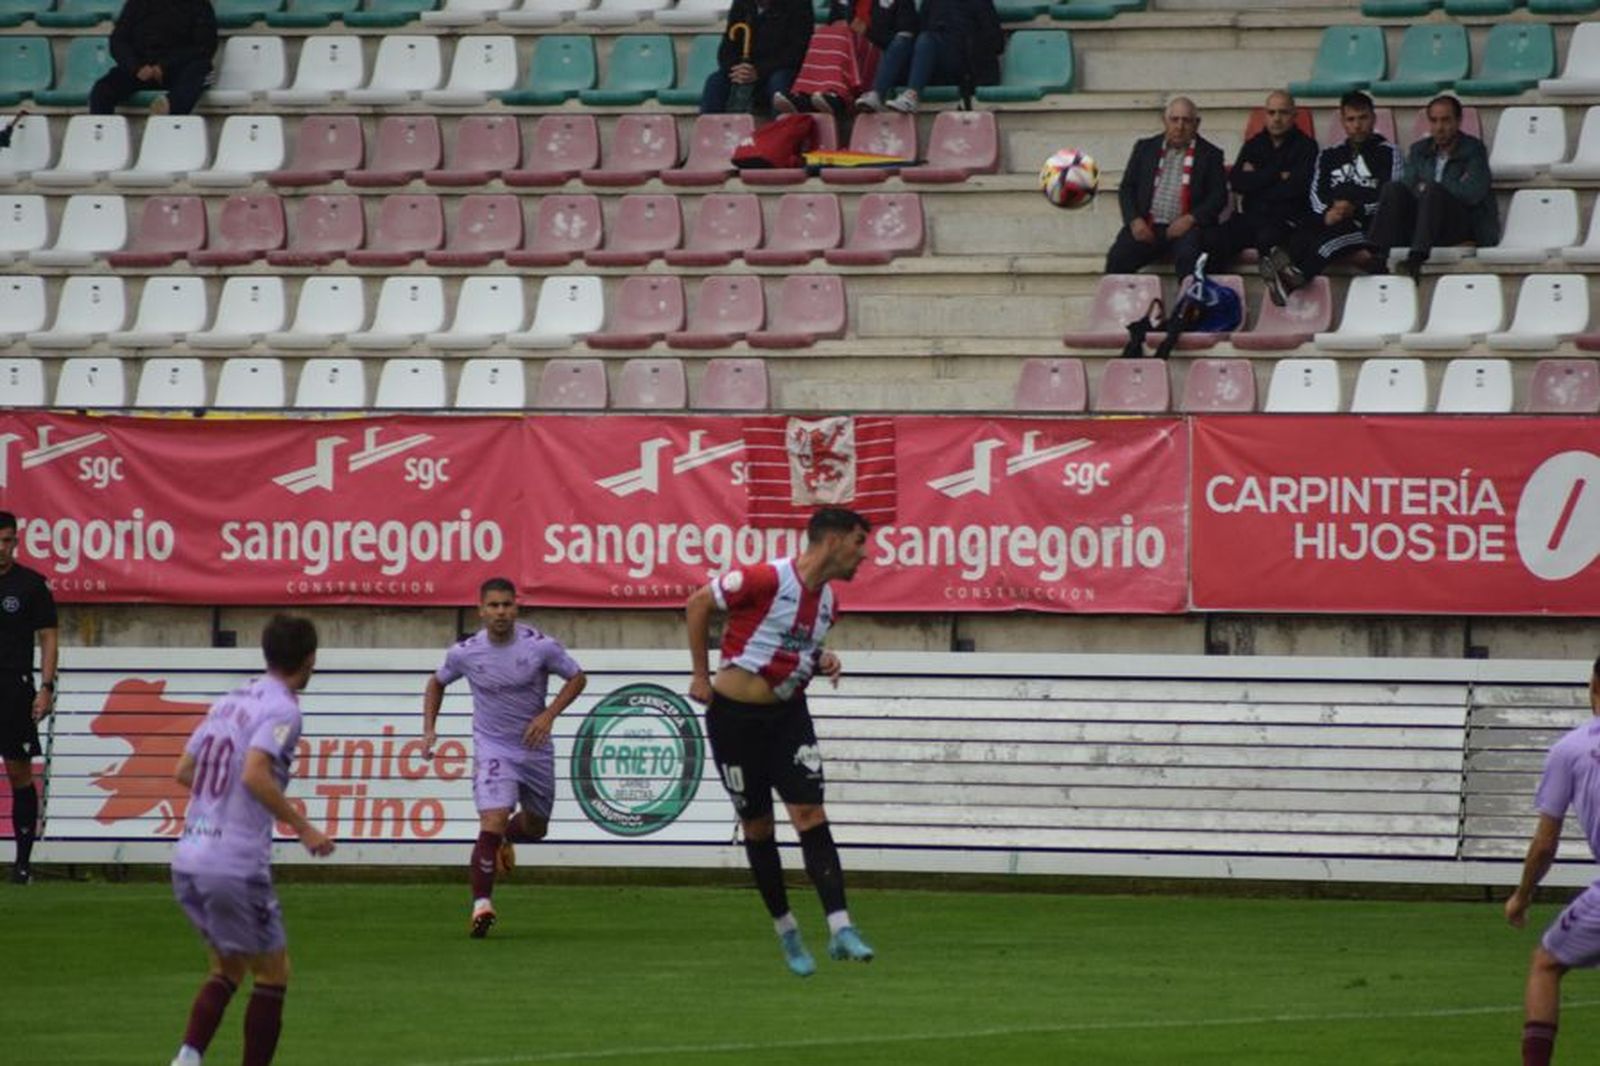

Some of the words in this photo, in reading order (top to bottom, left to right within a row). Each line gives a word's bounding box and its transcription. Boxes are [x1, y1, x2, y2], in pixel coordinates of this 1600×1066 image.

[79, 456, 124, 489] sgc
[404, 456, 450, 490] sgc
[1062, 461, 1111, 495] sgc
[1205, 468, 1506, 516] CARPINTERÍA
[221, 508, 503, 575] sangregorio
[544, 522, 809, 578] sangregori
[874, 514, 1166, 581] sangregorio
[1294, 522, 1436, 562] HIJOS
[1446, 524, 1506, 562] DE
[286, 580, 435, 595] CONSTRUCCION
[610, 583, 698, 598] CONSTRU
[943, 586, 1096, 601] CONSTRUCCION
[194, 734, 235, 799] 10
[290, 725, 468, 781] arnice
[488, 758, 500, 777] 2
[600, 745, 676, 776] PRIETO
[721, 763, 745, 793] 10
[315, 784, 445, 838] Tino
